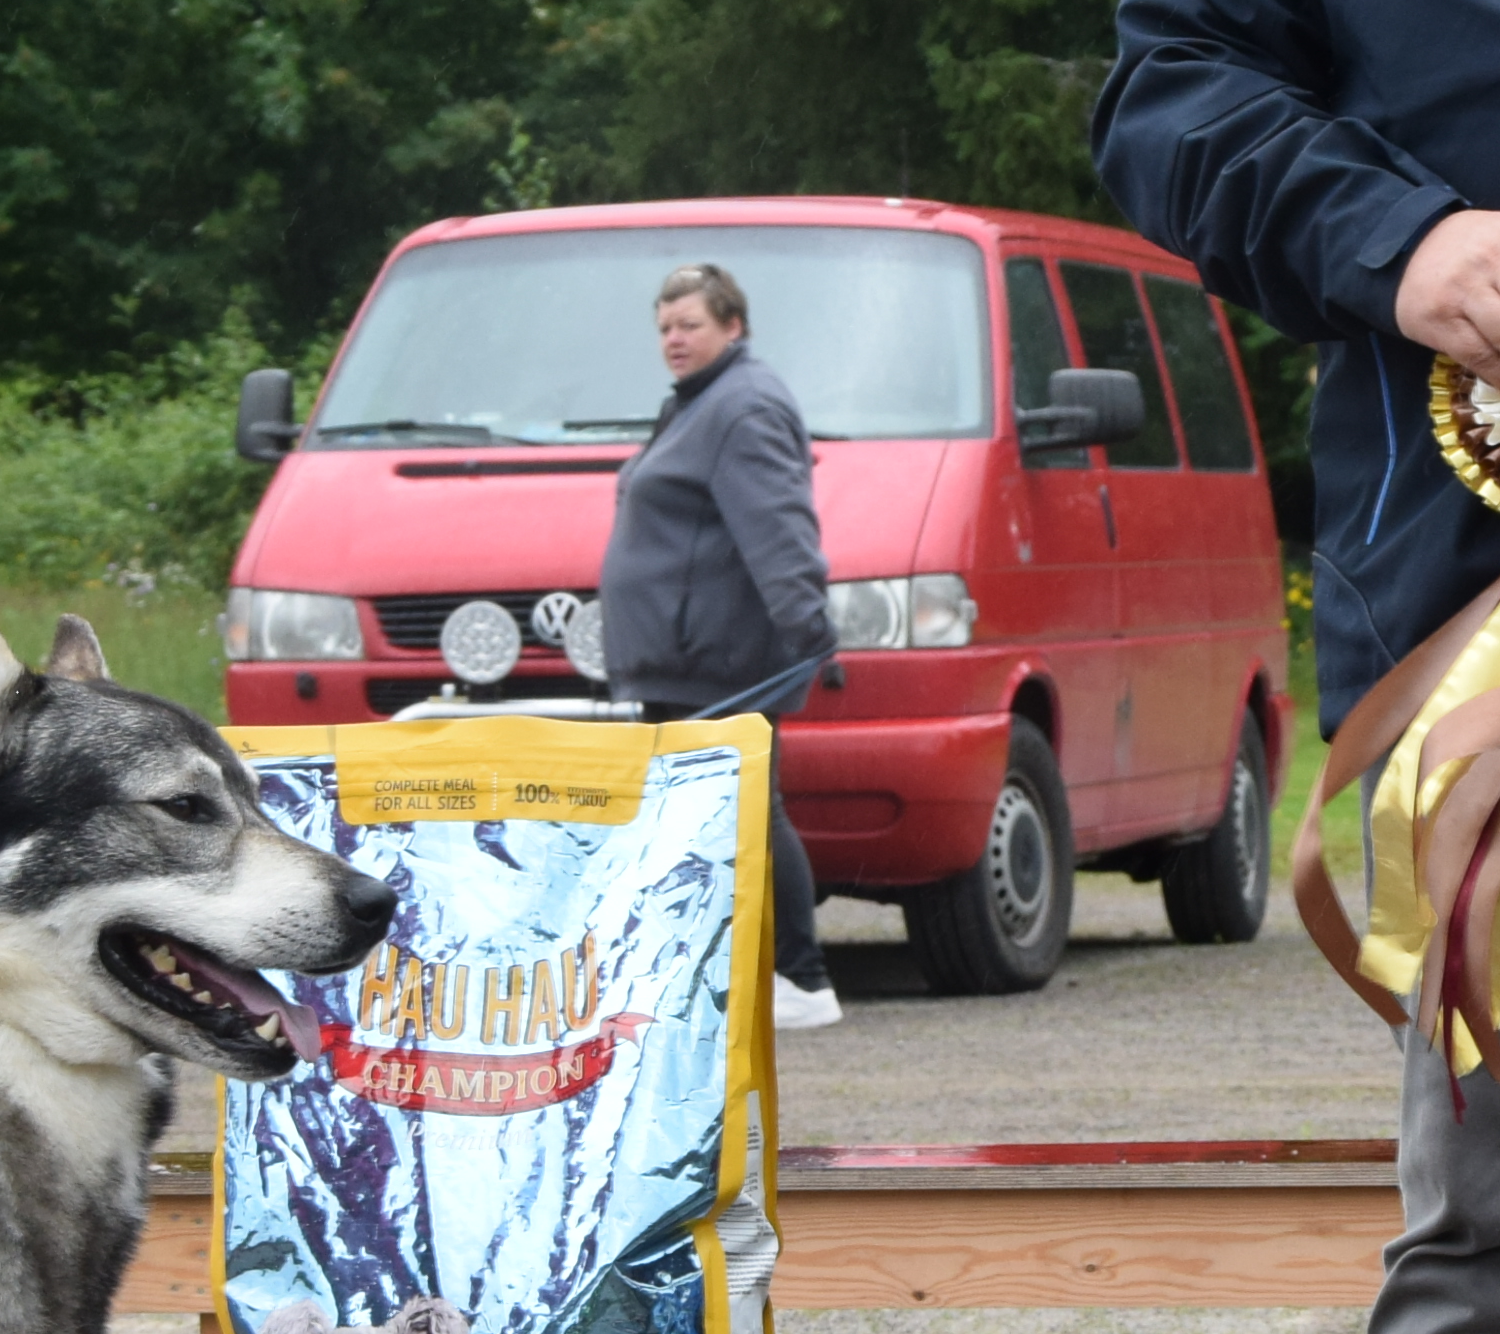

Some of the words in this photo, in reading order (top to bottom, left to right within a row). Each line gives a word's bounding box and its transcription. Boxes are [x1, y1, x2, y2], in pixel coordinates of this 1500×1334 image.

[373, 779, 441, 793] COMPLETE
[443, 777, 478, 791] MEAL
[514, 782, 561, 806] 100%
[373, 796, 403, 812] FOR
[406, 795, 433, 810] ALL
[437, 794, 477, 810] SIZES
[358, 942, 471, 1041] HAU
[479, 928, 600, 1046] HAU
[362, 1053, 586, 1103] CHAMPION
